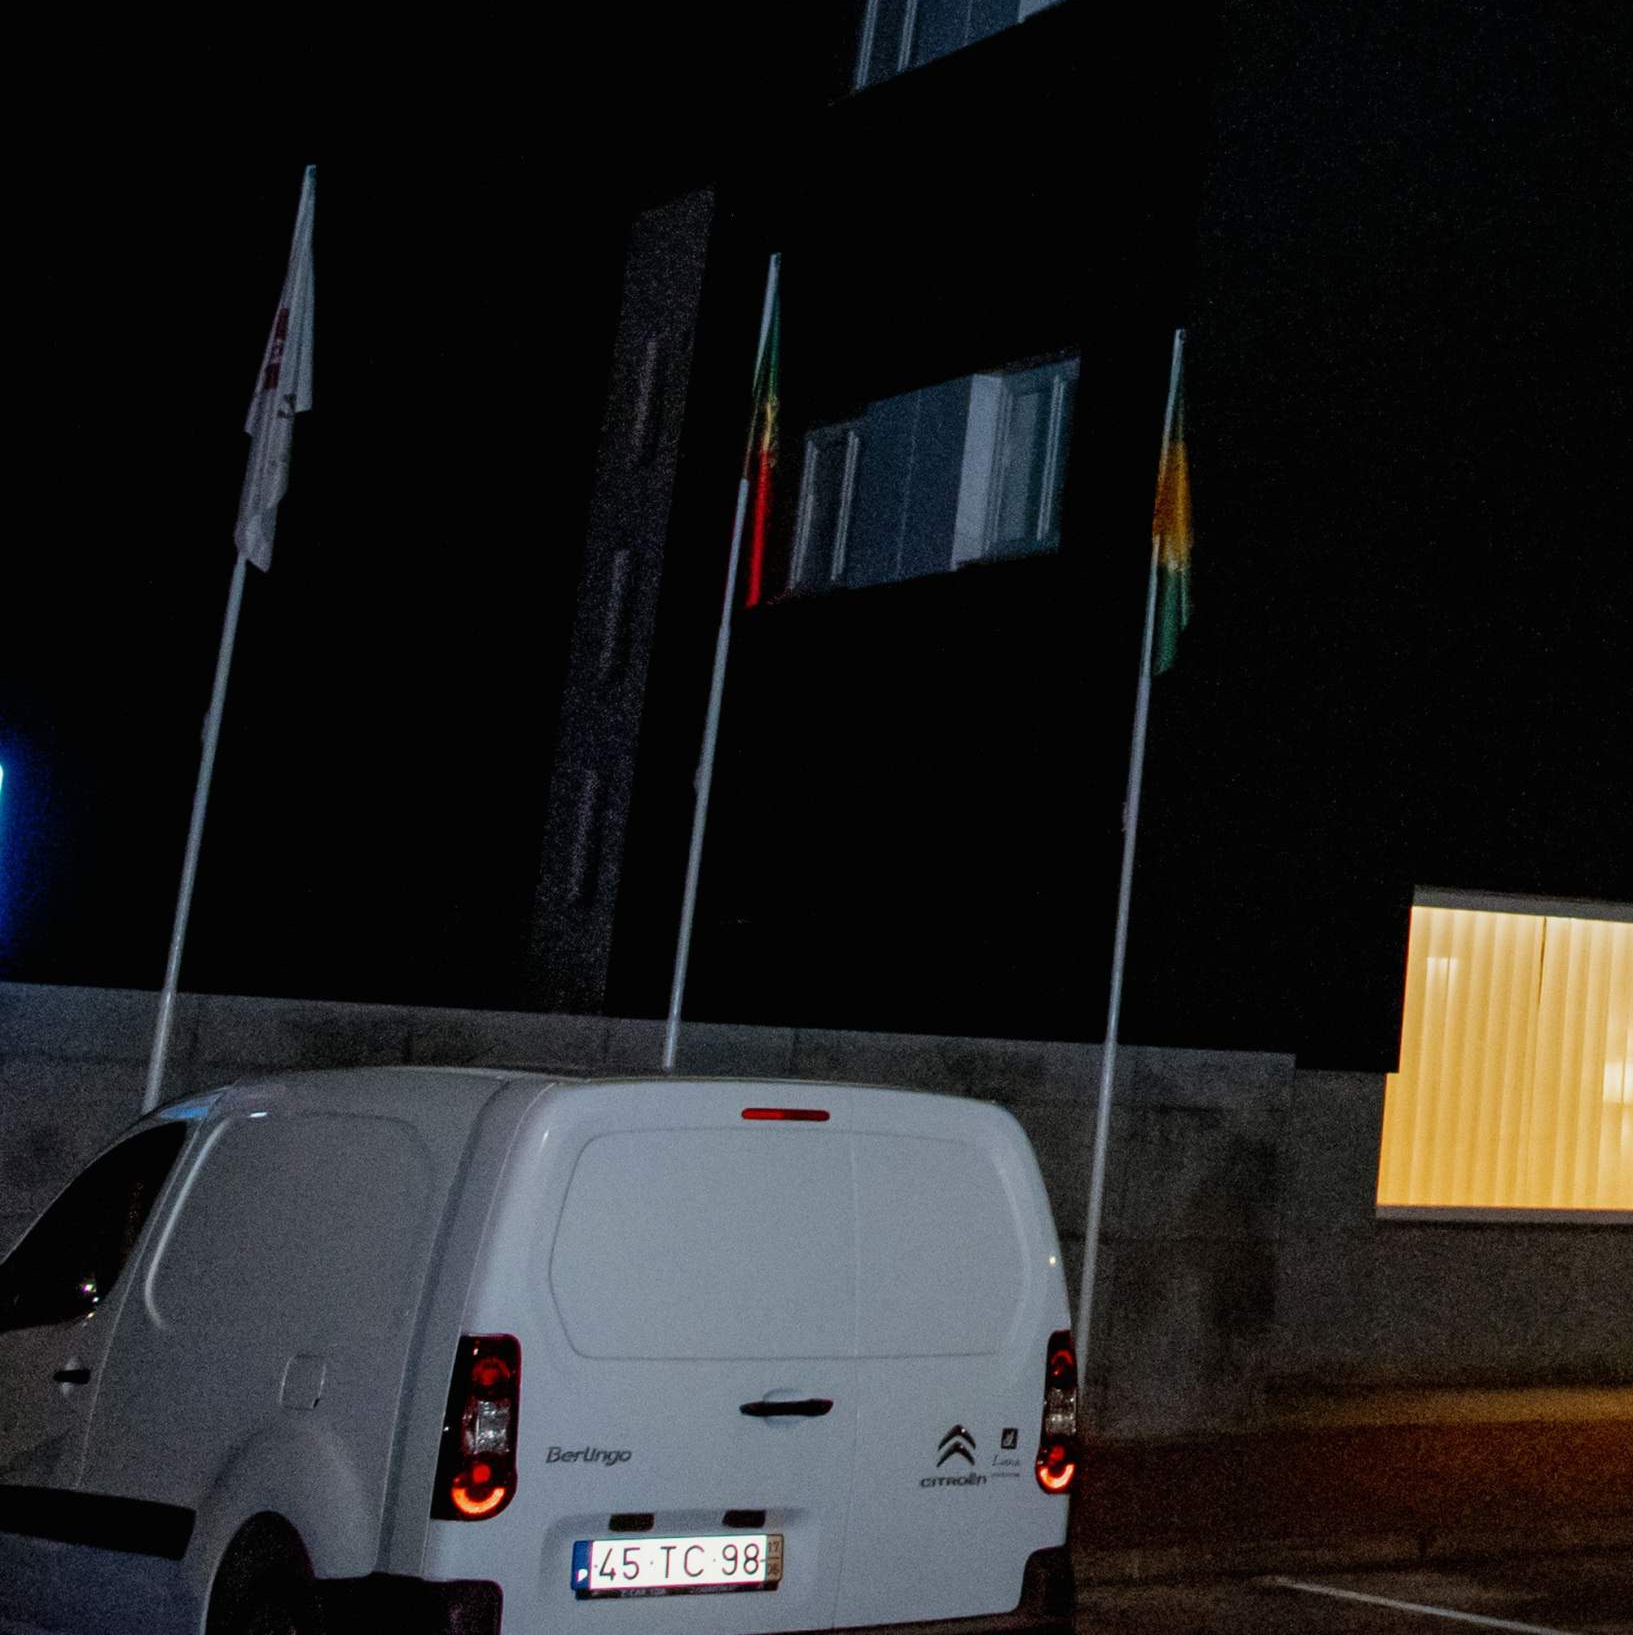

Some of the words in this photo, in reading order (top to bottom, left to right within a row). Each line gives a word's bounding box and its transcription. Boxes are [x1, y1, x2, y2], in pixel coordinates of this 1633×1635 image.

[545, 1446, 632, 1466] Berlingo
[599, 1547, 640, 1581] 45
[660, 1544, 705, 1578] TC
[722, 1543, 760, 1576] 98
